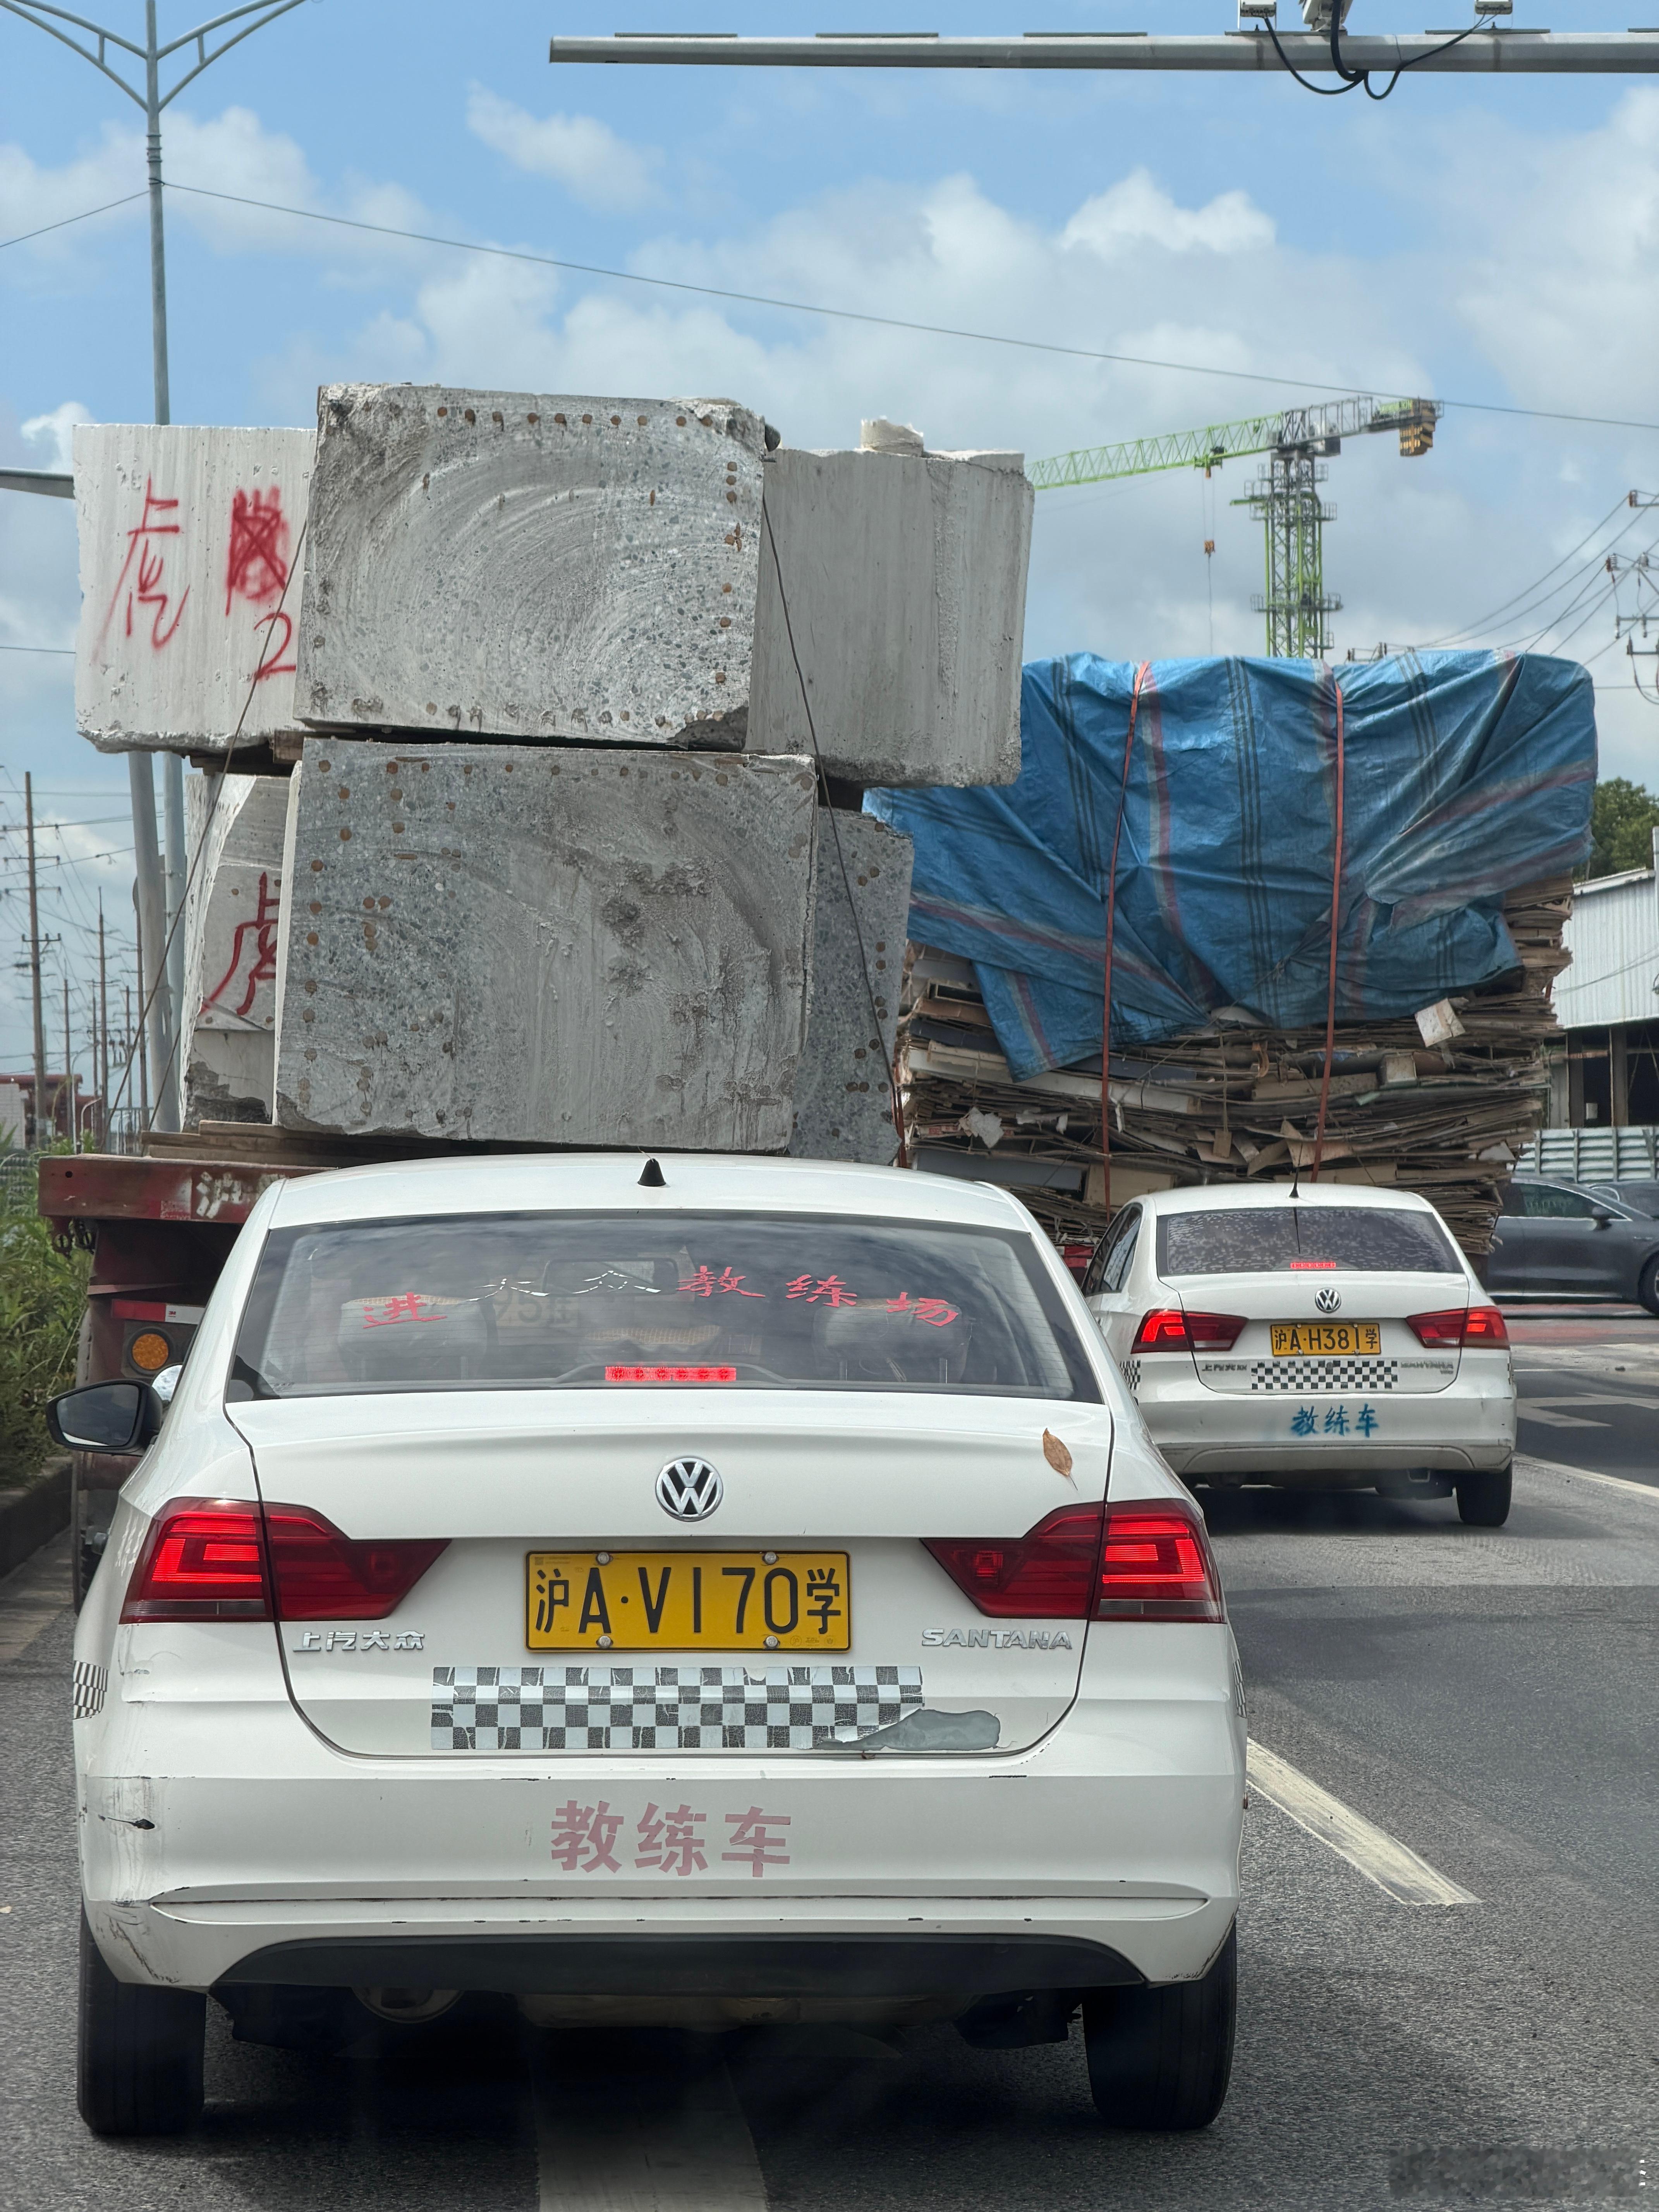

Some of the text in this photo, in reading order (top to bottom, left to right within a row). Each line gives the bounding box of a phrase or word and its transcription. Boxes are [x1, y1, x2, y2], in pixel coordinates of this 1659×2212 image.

[1316, 1288, 1341, 1313] VW
[1274, 1328, 1378, 1350] 沪A·H381学
[1290, 1403, 1379, 1442] 教练车
[656, 1457, 723, 1522] VW
[536, 1566, 842, 1634] 沪A·V170学
[293, 1630, 425, 1652] 上汽大众
[922, 1628, 1072, 1650] SANTANA
[551, 1800, 791, 1878] 教练车
